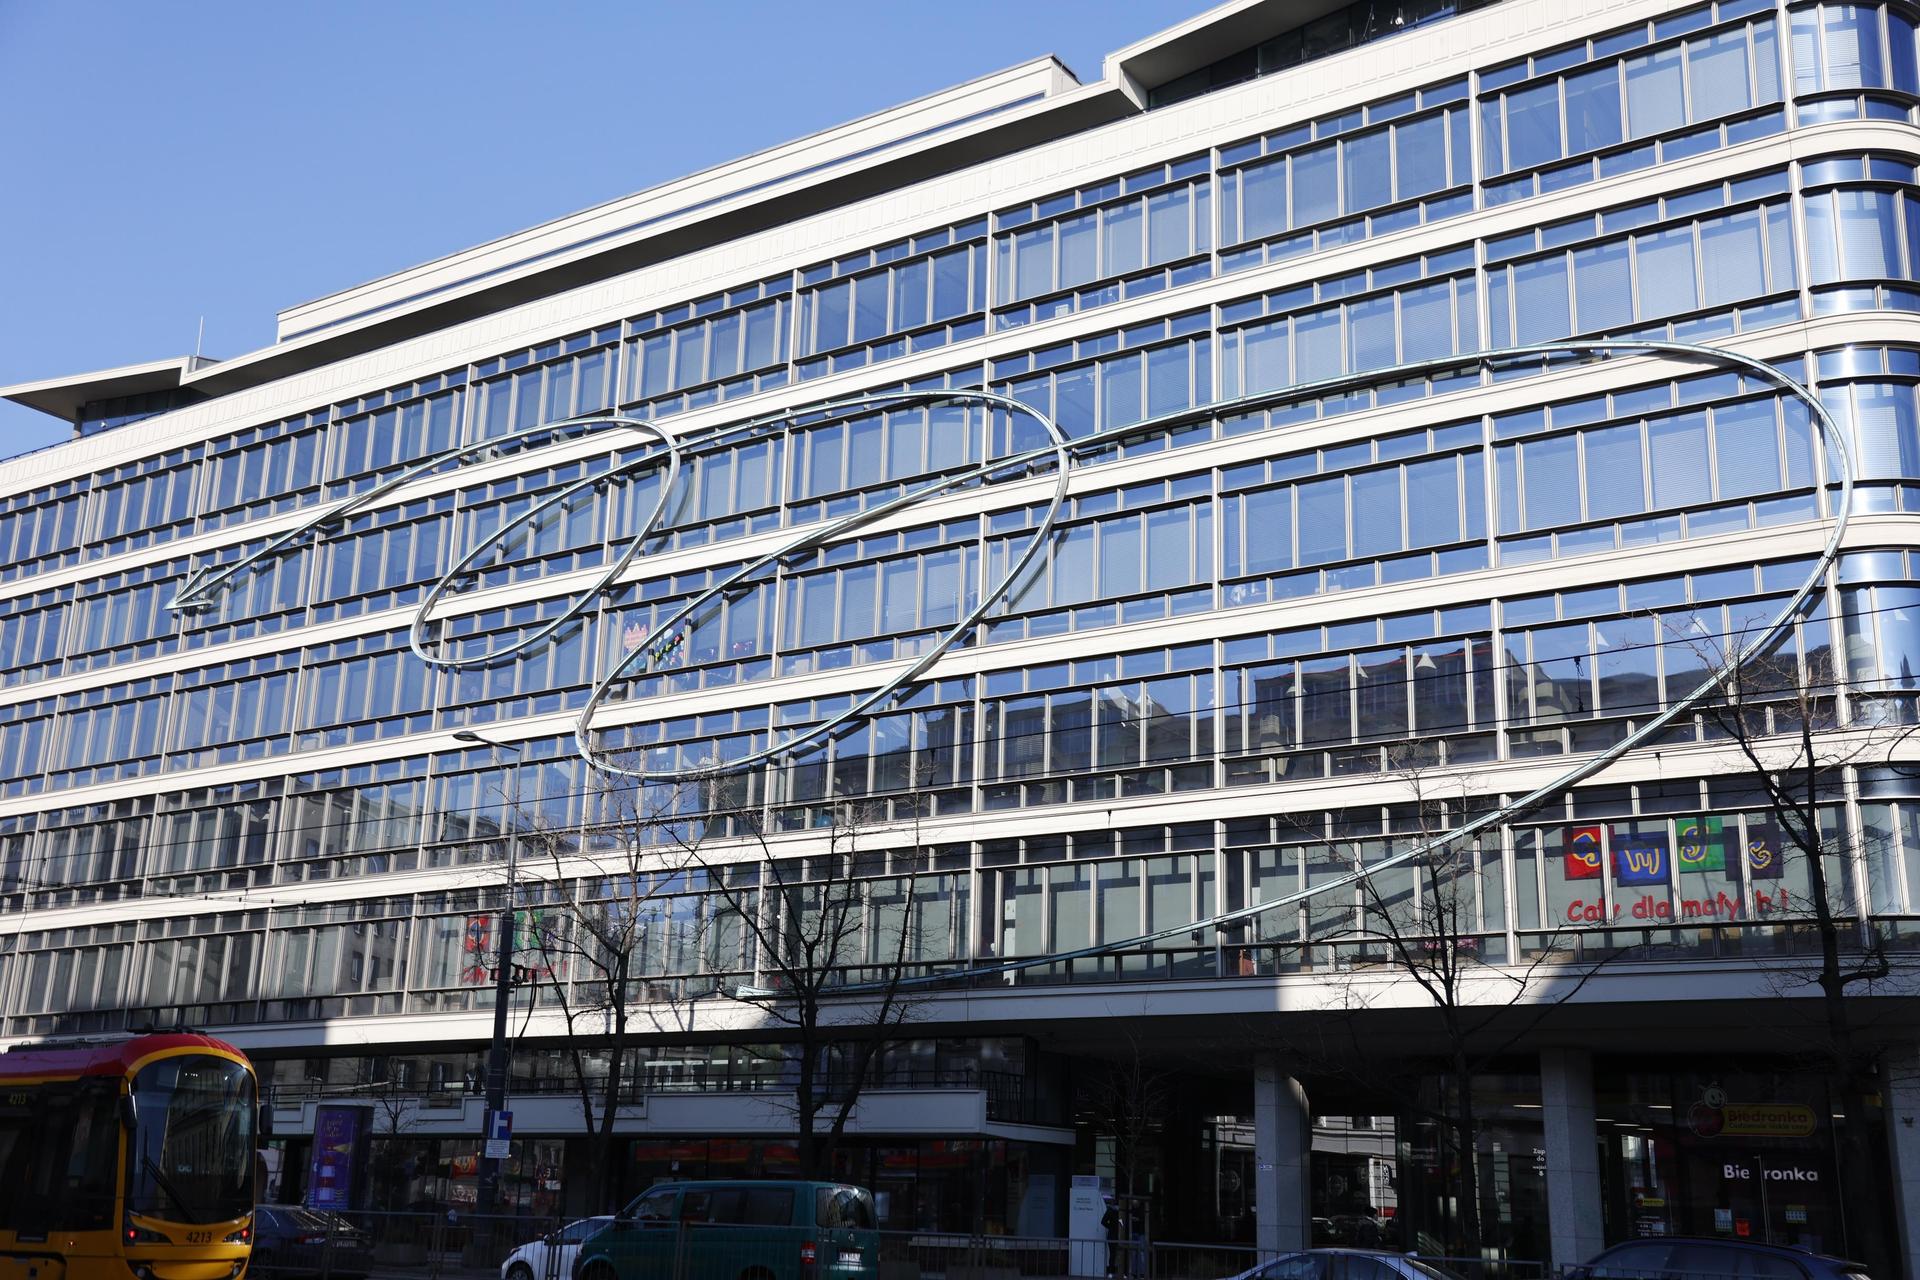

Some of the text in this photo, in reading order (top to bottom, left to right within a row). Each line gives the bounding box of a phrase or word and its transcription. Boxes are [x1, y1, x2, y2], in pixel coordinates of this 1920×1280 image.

[1632, 895, 1670, 919] dla
[1729, 1110, 1808, 1123] Biedronka
[1723, 1164, 1819, 1182] Bieronka
[186, 1231, 212, 1244] 4213
